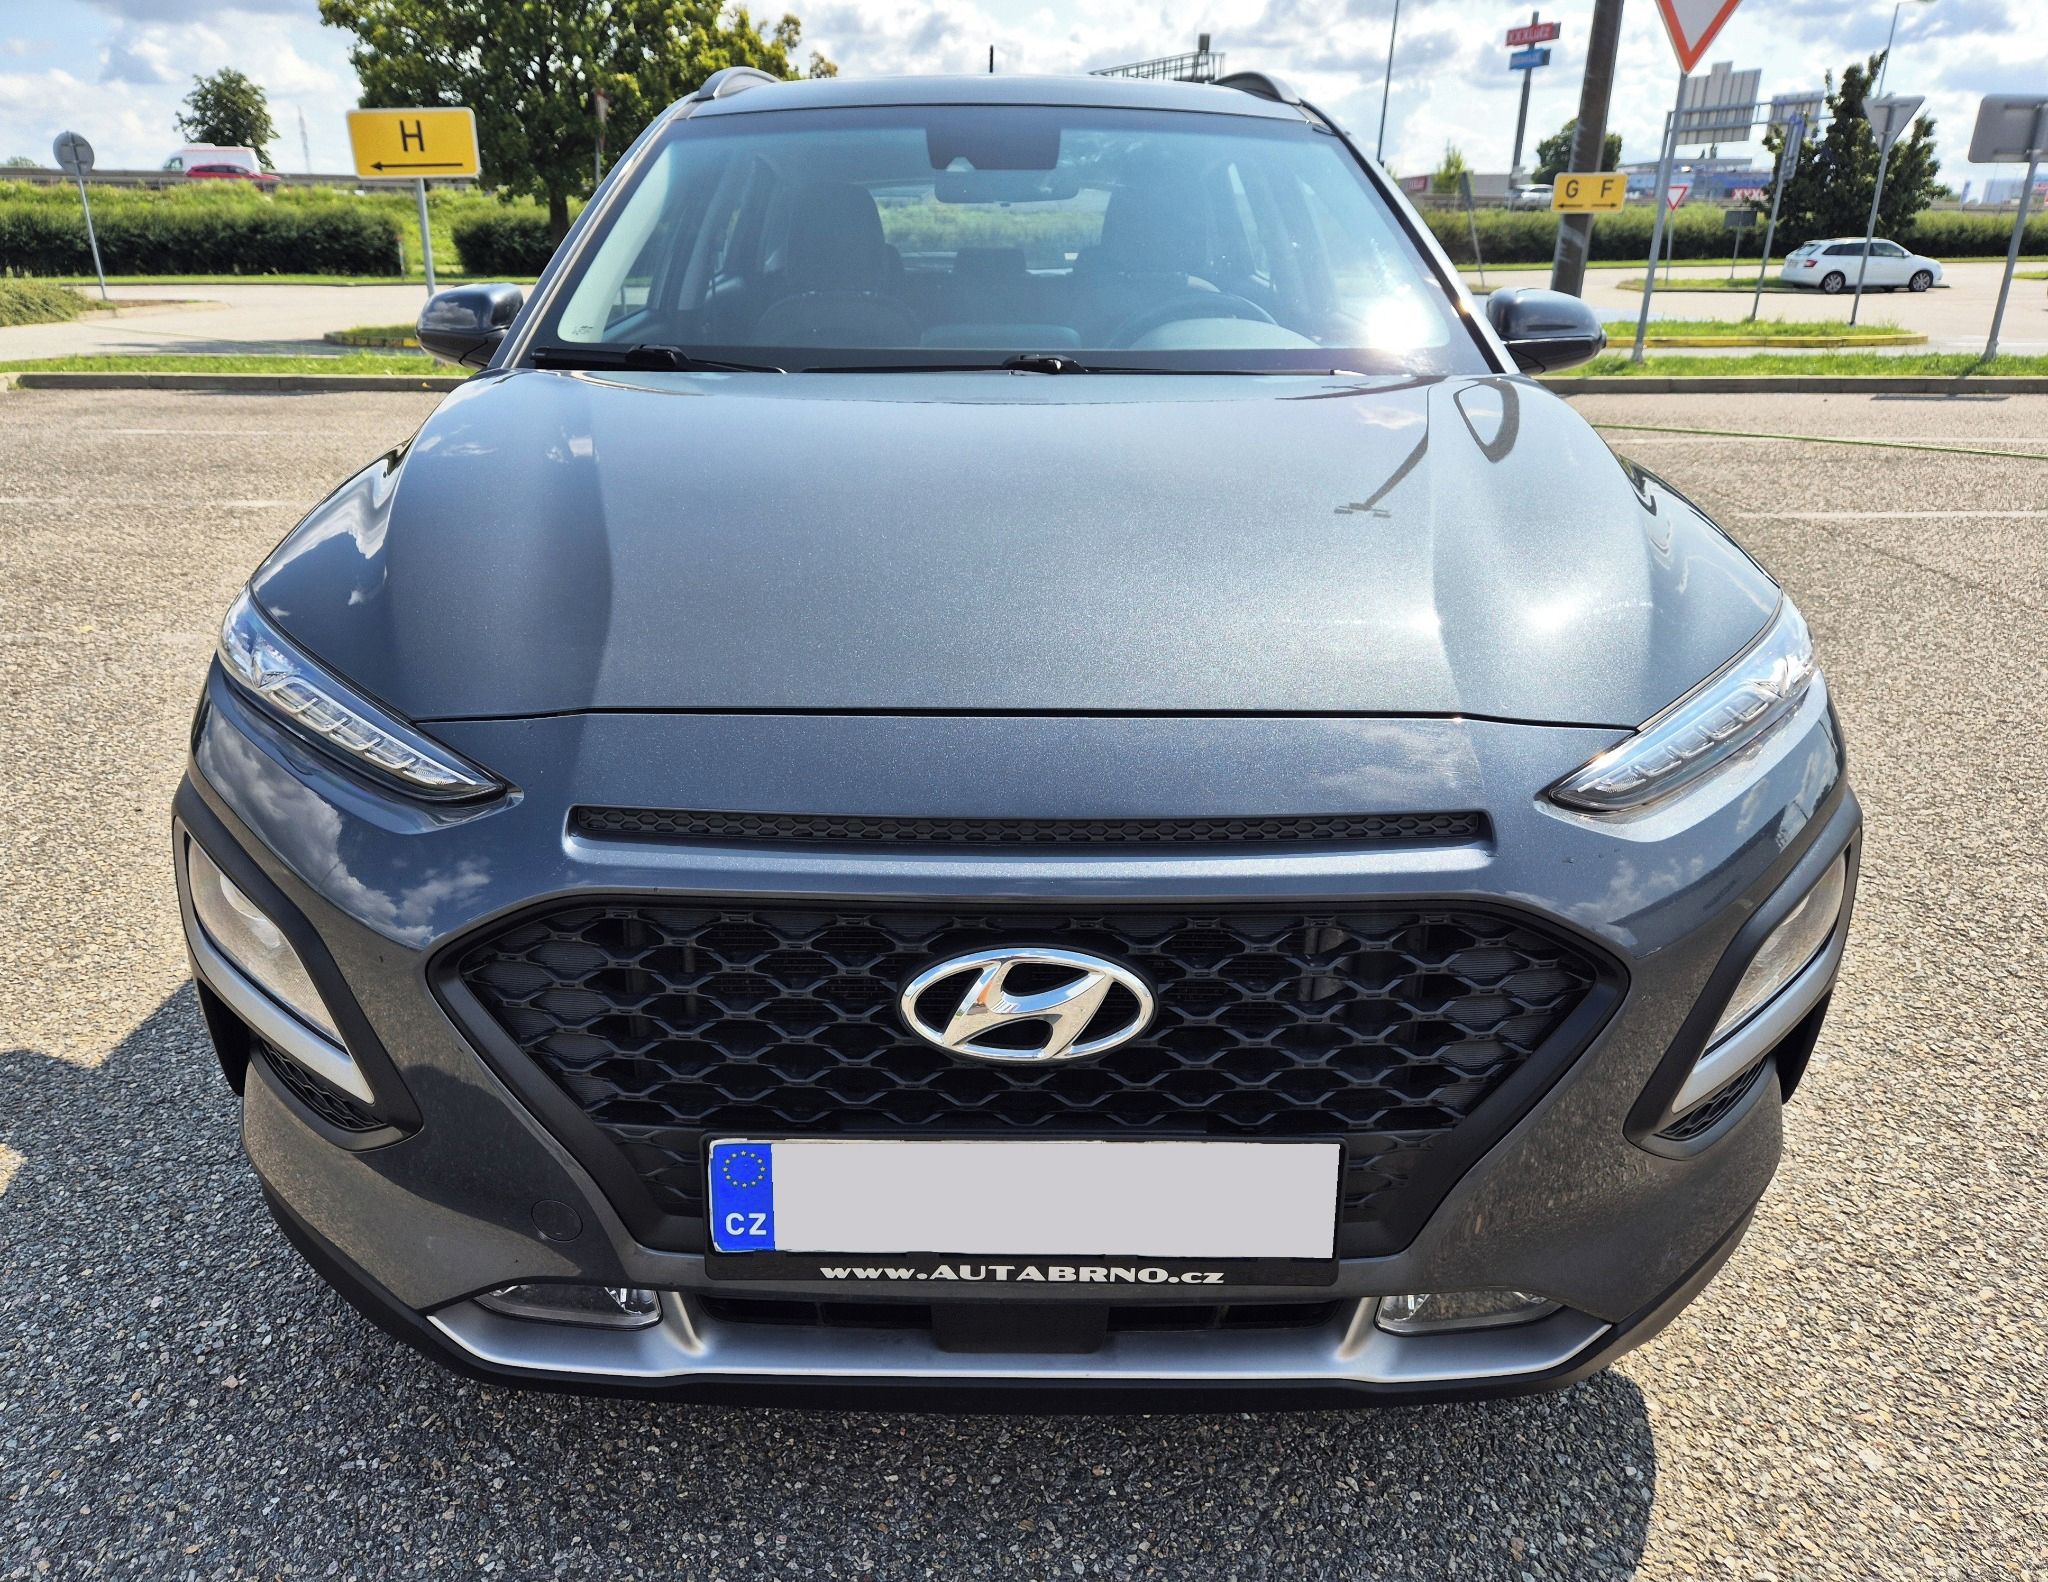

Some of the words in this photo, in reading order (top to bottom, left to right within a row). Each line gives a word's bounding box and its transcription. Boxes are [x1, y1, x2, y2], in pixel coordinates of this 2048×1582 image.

[399, 119, 425, 152] H
[1565, 179, 1579, 199] G
[1600, 179, 1615, 199] F
[725, 1212, 767, 1236] CZ
[819, 1264, 1225, 1284] www.AUTABRNO.cz
